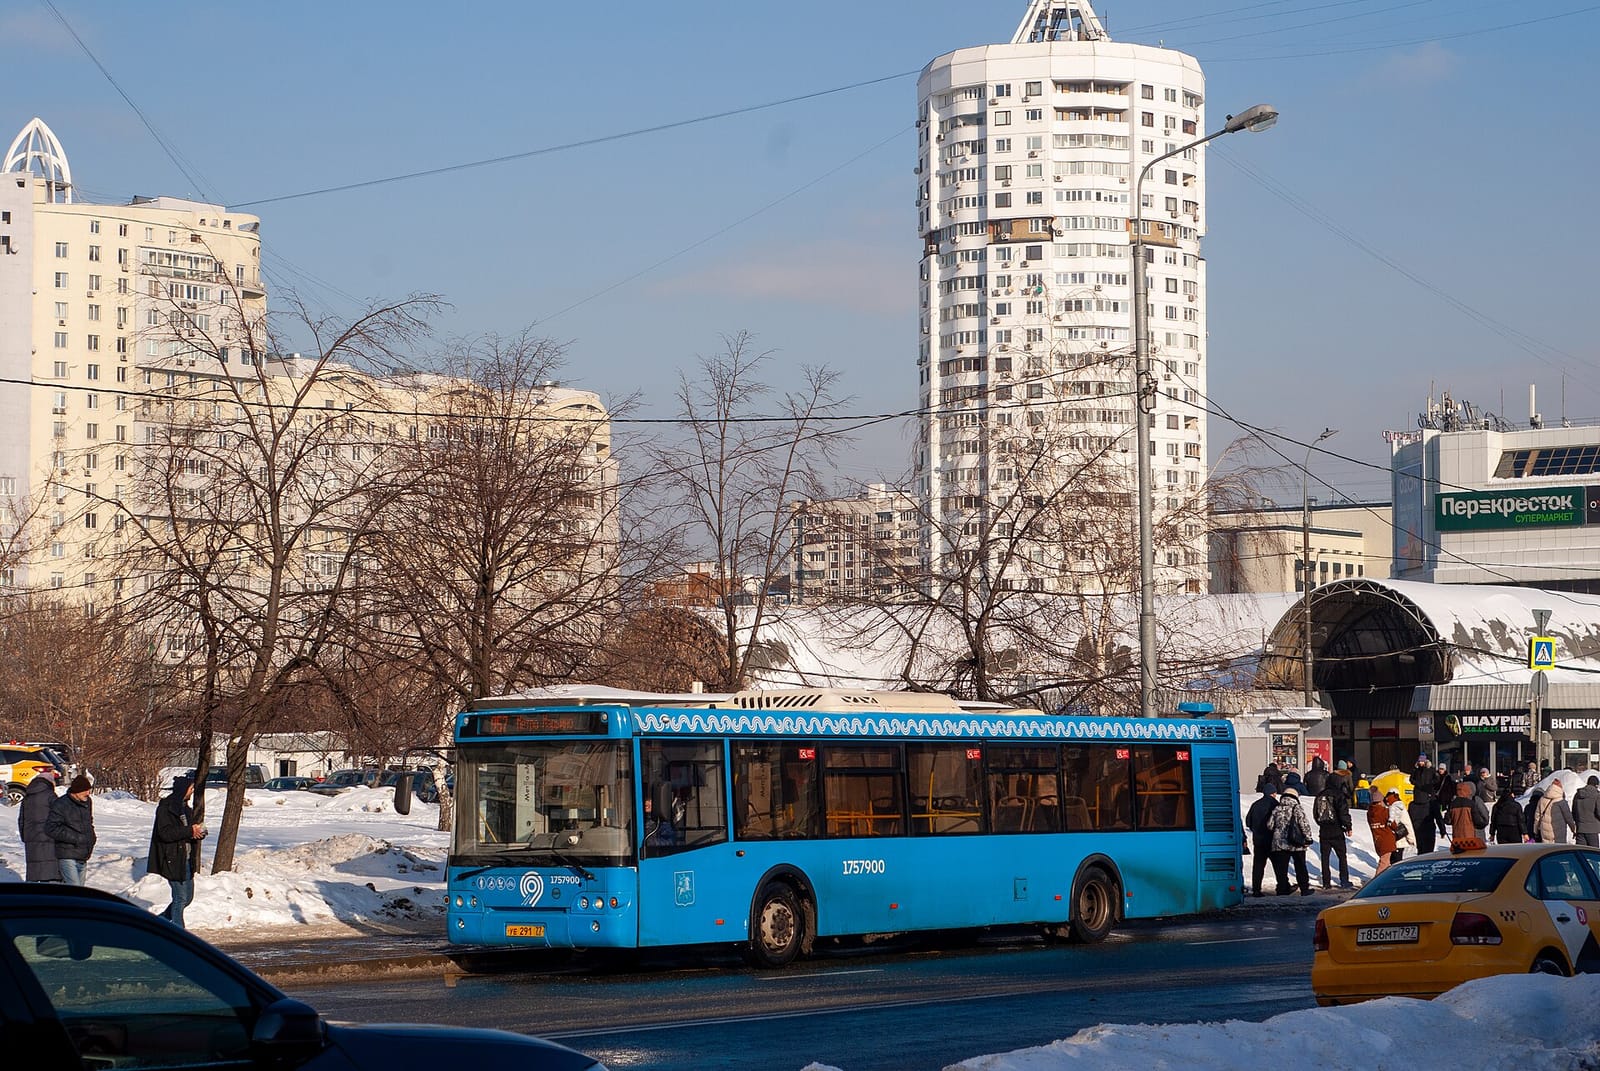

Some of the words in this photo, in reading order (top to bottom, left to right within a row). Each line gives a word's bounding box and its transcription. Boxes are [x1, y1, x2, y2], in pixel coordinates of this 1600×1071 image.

[1441, 495, 1573, 519] Перекресток
[1515, 512, 1574, 523] СУПЕРМАРКЕТ
[842, 859, 885, 875] 1757900
[550, 875, 580, 885] 1757900
[519, 926, 532, 936] 291
[1360, 928, 1398, 941] Т856МТ
[1400, 927, 1416, 937] 797
